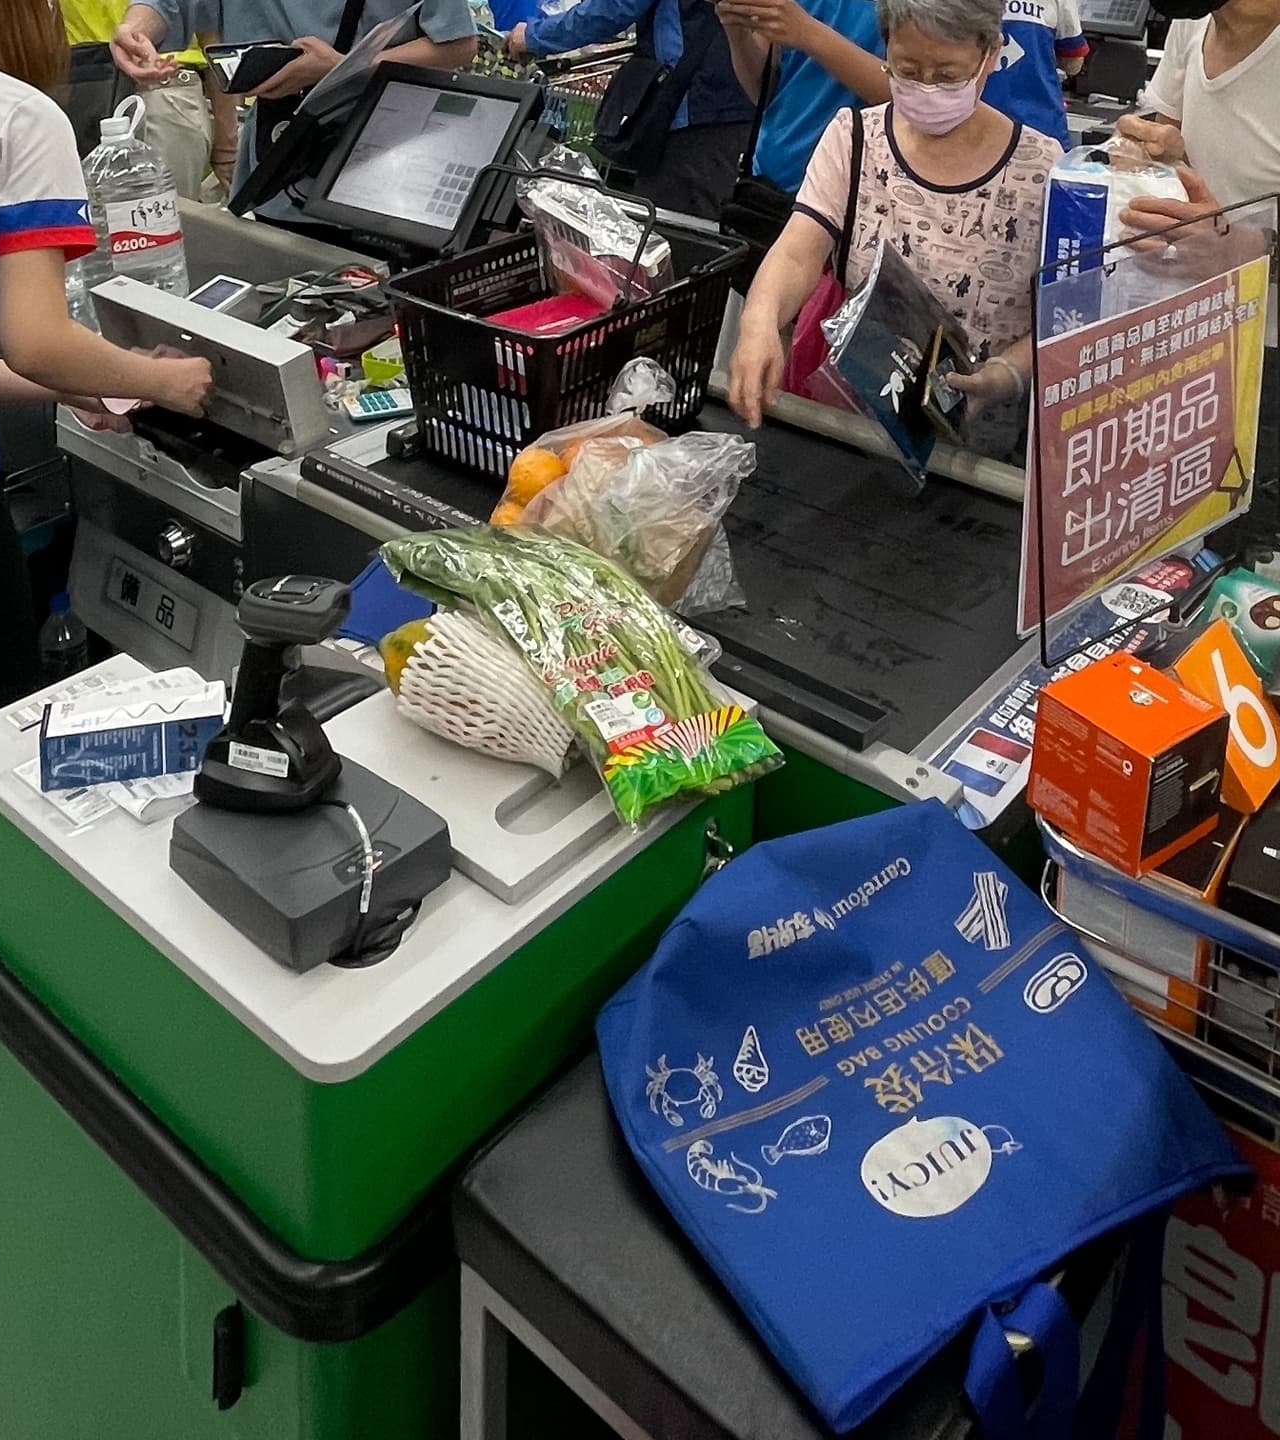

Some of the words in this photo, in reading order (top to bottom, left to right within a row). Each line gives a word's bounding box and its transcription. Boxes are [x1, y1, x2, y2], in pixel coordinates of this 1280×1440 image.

[113, 237, 148, 252] 6200
[1061, 371, 1220, 498] 即期品
[1060, 436, 1217, 568] 出清區
[831, 855, 912, 924] Carrefour
[794, 948, 957, 1057] 僅供店內使用
[882, 995, 972, 1049] COOLING
[835, 1044, 879, 1079] BAG
[863, 1022, 1006, 1114] 保冷袋
[870, 1128, 978, 1203] JUICY!
